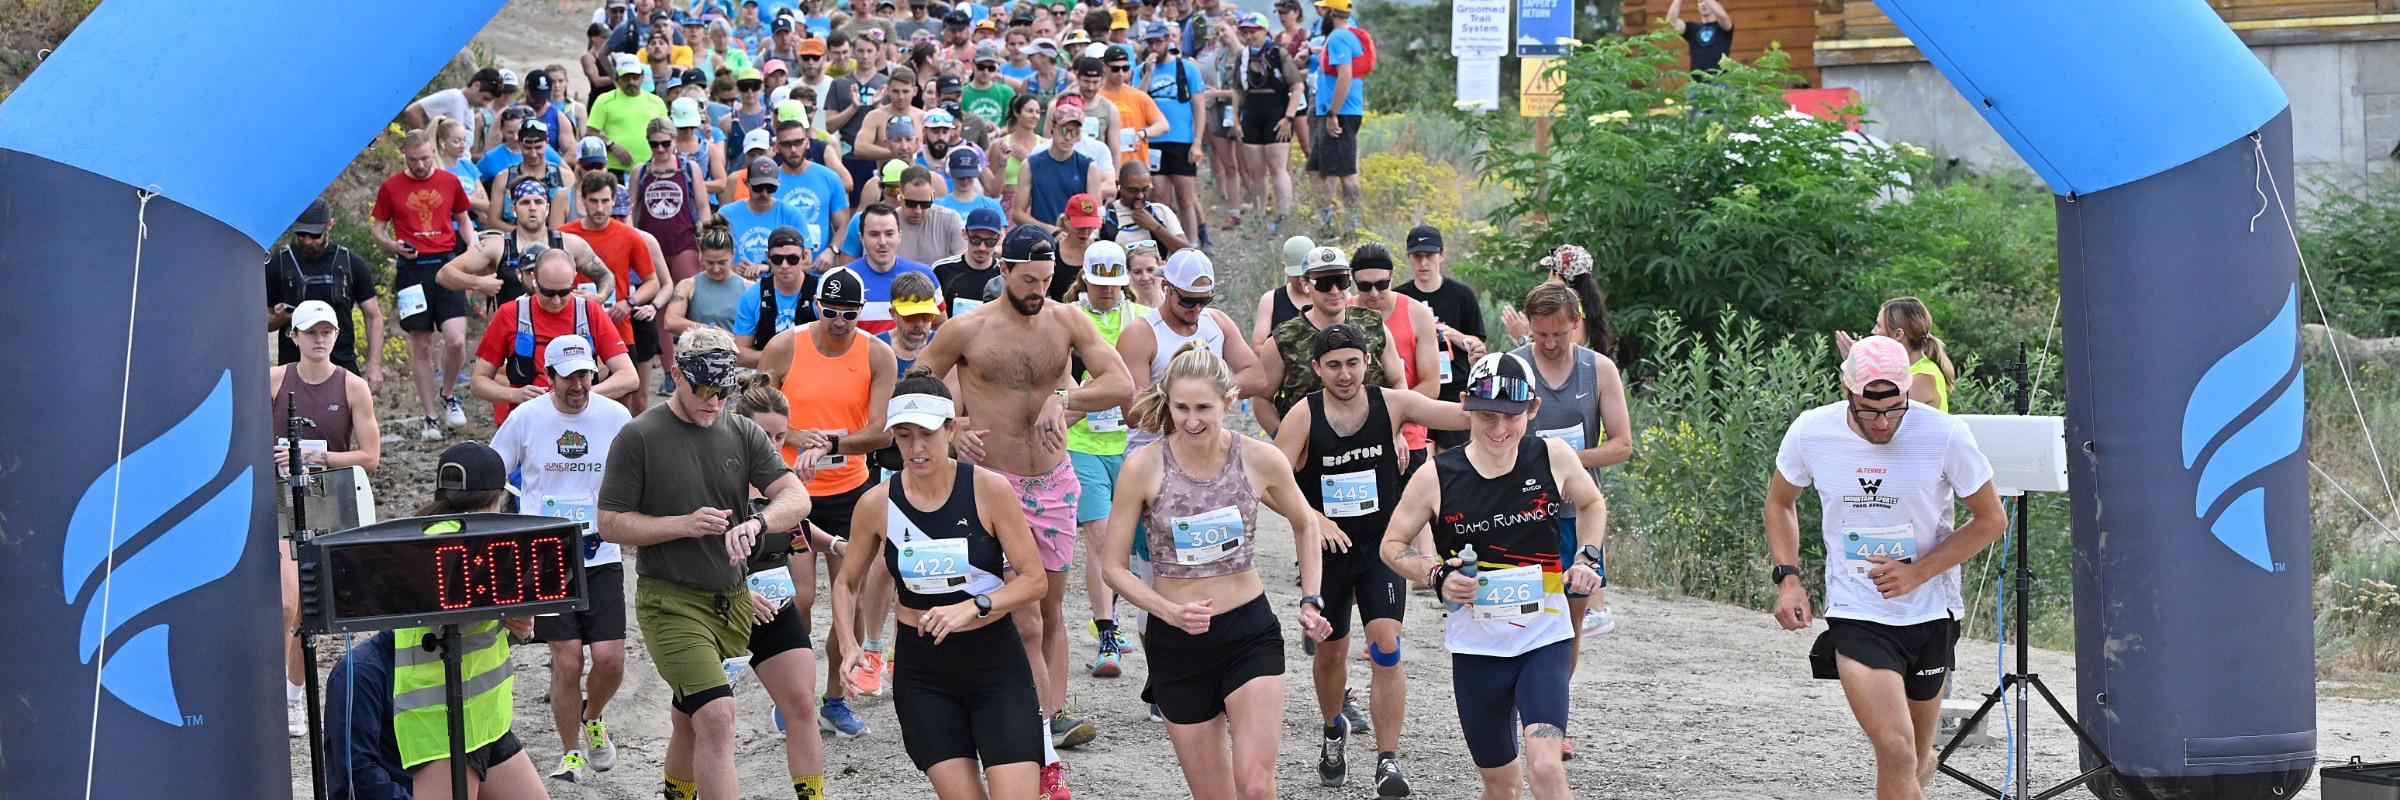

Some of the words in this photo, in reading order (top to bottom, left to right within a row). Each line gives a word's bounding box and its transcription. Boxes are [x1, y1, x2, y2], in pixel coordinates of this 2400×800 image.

[1457, 5, 1505, 13] Groomed
[1521, 8, 1551, 18] RETURN
[1470, 14, 1491, 22] Trail
[1462, 24, 1498, 33] System
[1322, 444, 1383, 467] BOSTON
[570, 463, 602, 472] 2012
[1332, 484, 1368, 501] 445
[1522, 484, 1541, 492] SUGOI
[1875, 496, 1899, 504] SPORTS
[552, 507, 586, 520] 446
[1445, 512, 1464, 524] Shu's
[1454, 520, 1490, 534] IDAHO
[1493, 509, 1544, 528] RUNNING
[1189, 525, 1228, 547] 301
[1856, 541, 1905, 558] 444
[912, 556, 957, 576] 422
[2274, 562, 2286, 572] TM
[435, 537, 567, 610] 0:00
[757, 582, 788, 598] 326
[1485, 583, 1531, 604] 426
[1925, 666, 1945, 675] TERREX
[185, 714, 204, 726] TM
